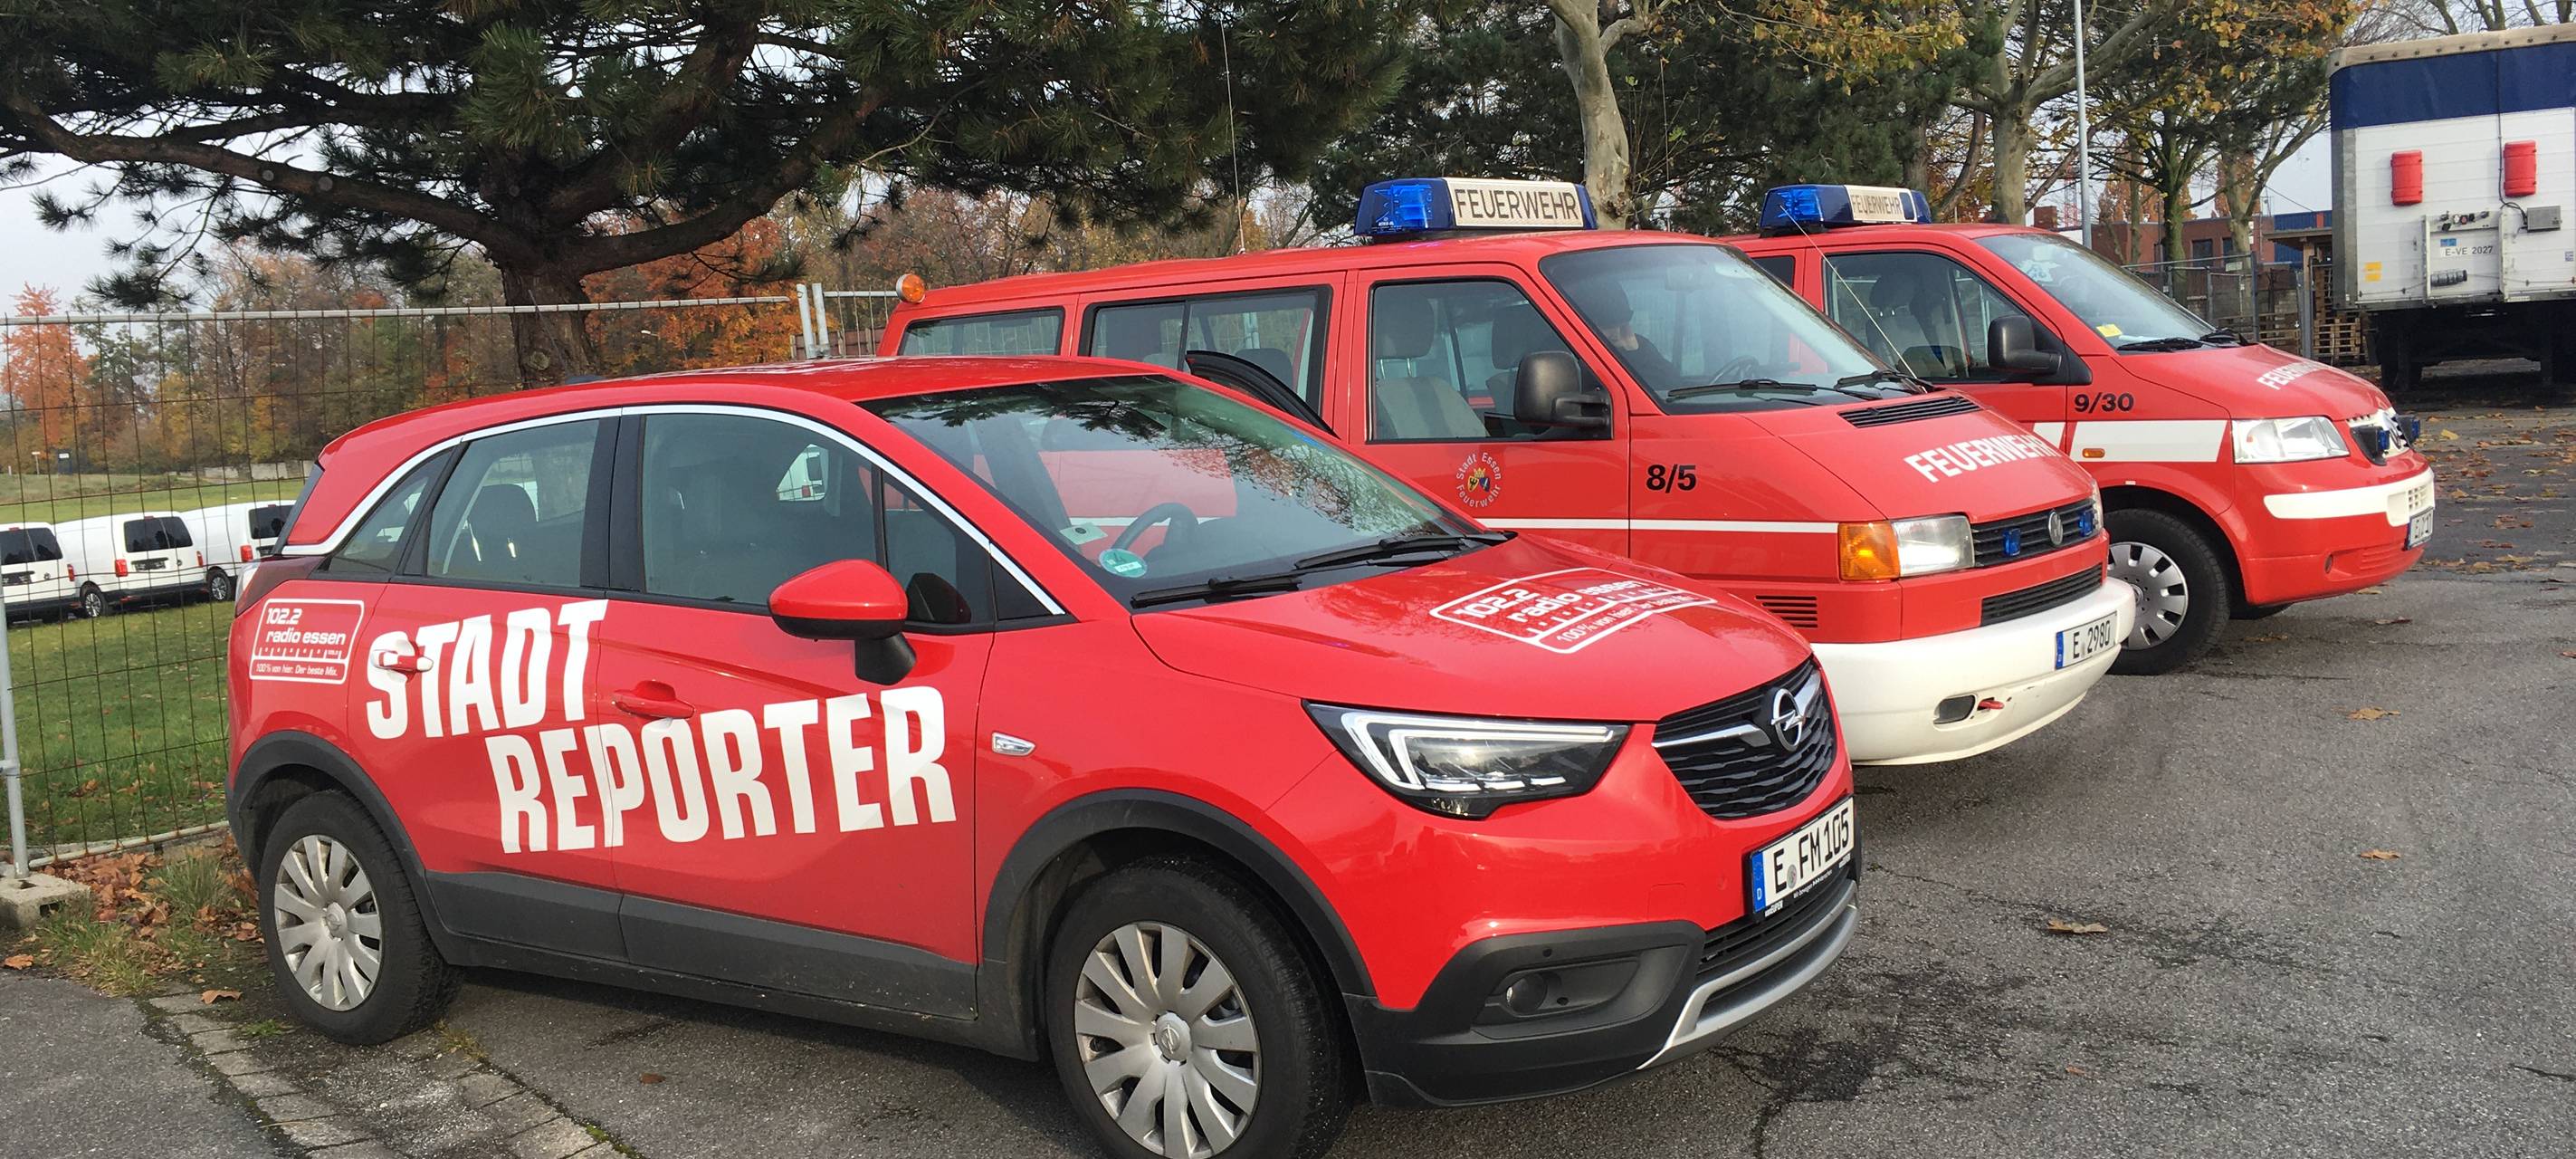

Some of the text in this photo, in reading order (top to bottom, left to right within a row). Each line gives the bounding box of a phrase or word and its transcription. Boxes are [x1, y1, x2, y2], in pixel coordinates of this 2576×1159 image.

[1454, 188, 1579, 220] FEUERWEHR
[1852, 194, 1902, 215] FEUERWEHR
[2074, 392, 2134, 413] 9/30
[1456, 452, 1502, 480] Stadt Essen
[1903, 435, 2062, 483] FEUERWEHR
[1646, 464, 1696, 493] 8/5
[1456, 484, 1501, 508] Feuerwehr
[266, 608, 303, 625] 102.2
[1453, 589, 1541, 618] 102.2
[1506, 593, 1582, 623] radio
[265, 627, 346, 645] radio essen
[2073, 620, 2110, 659] E 2980
[366, 599, 609, 740] STADT
[484, 685, 957, 854] REPORTER
[1773, 848, 1787, 894] E
